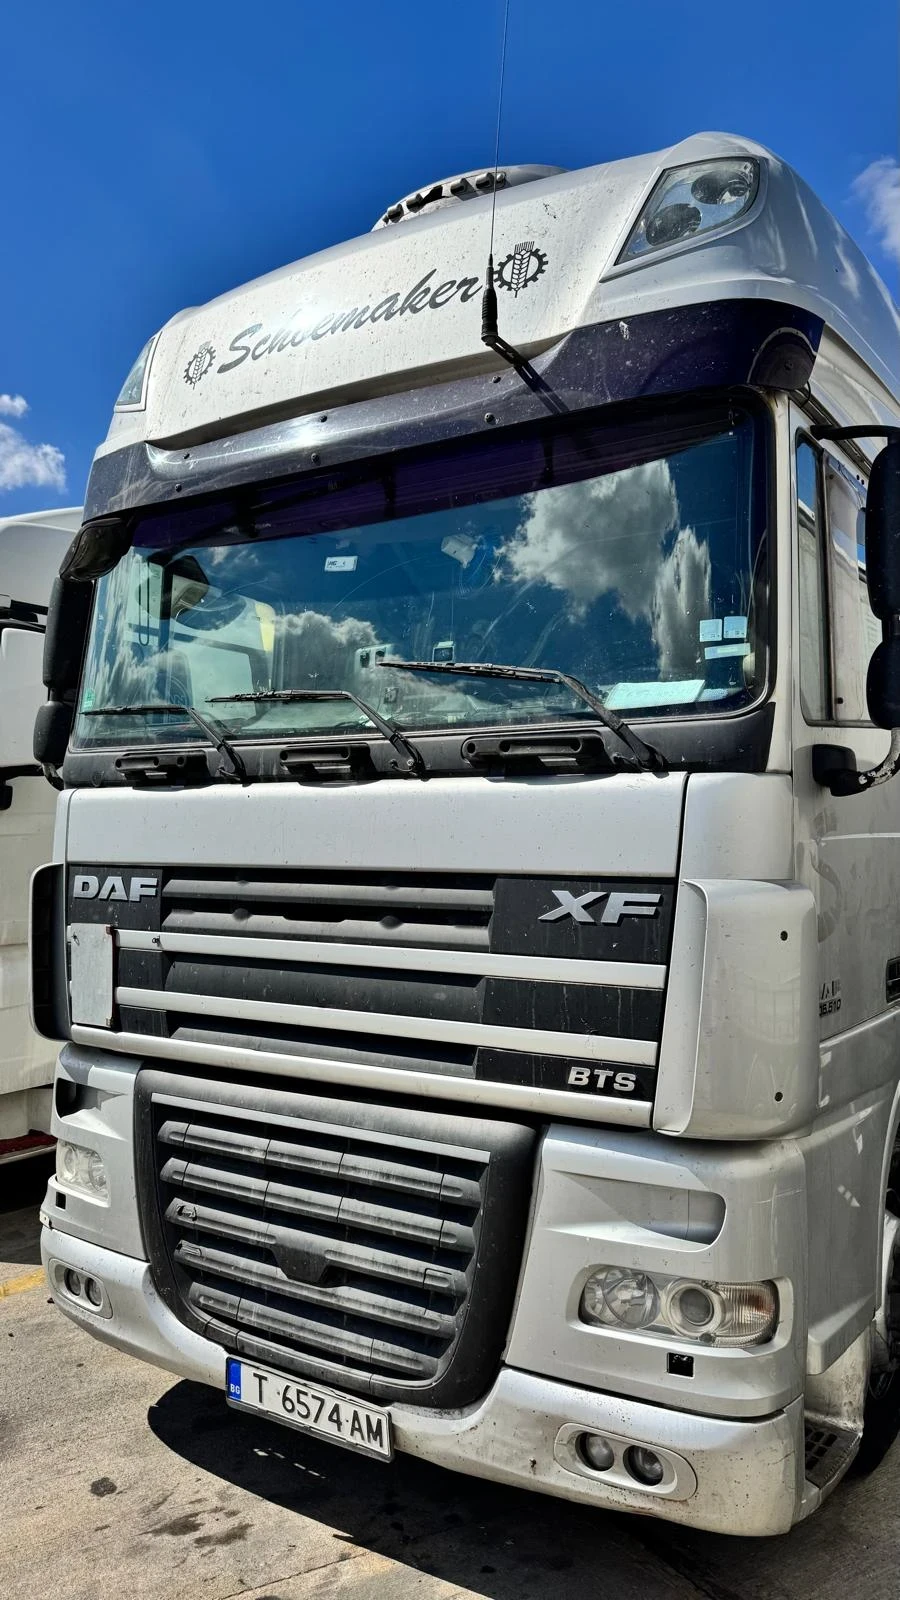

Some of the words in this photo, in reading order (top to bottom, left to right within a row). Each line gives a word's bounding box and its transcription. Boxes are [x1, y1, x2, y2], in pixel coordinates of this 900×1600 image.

[73, 875, 158, 902] DAF
[538, 890, 662, 924] XF
[567, 1066, 637, 1092] BTS
[230, 1383, 241, 1394] BG
[282, 1385, 343, 1432] 6574
[350, 1410, 384, 1448] AM
